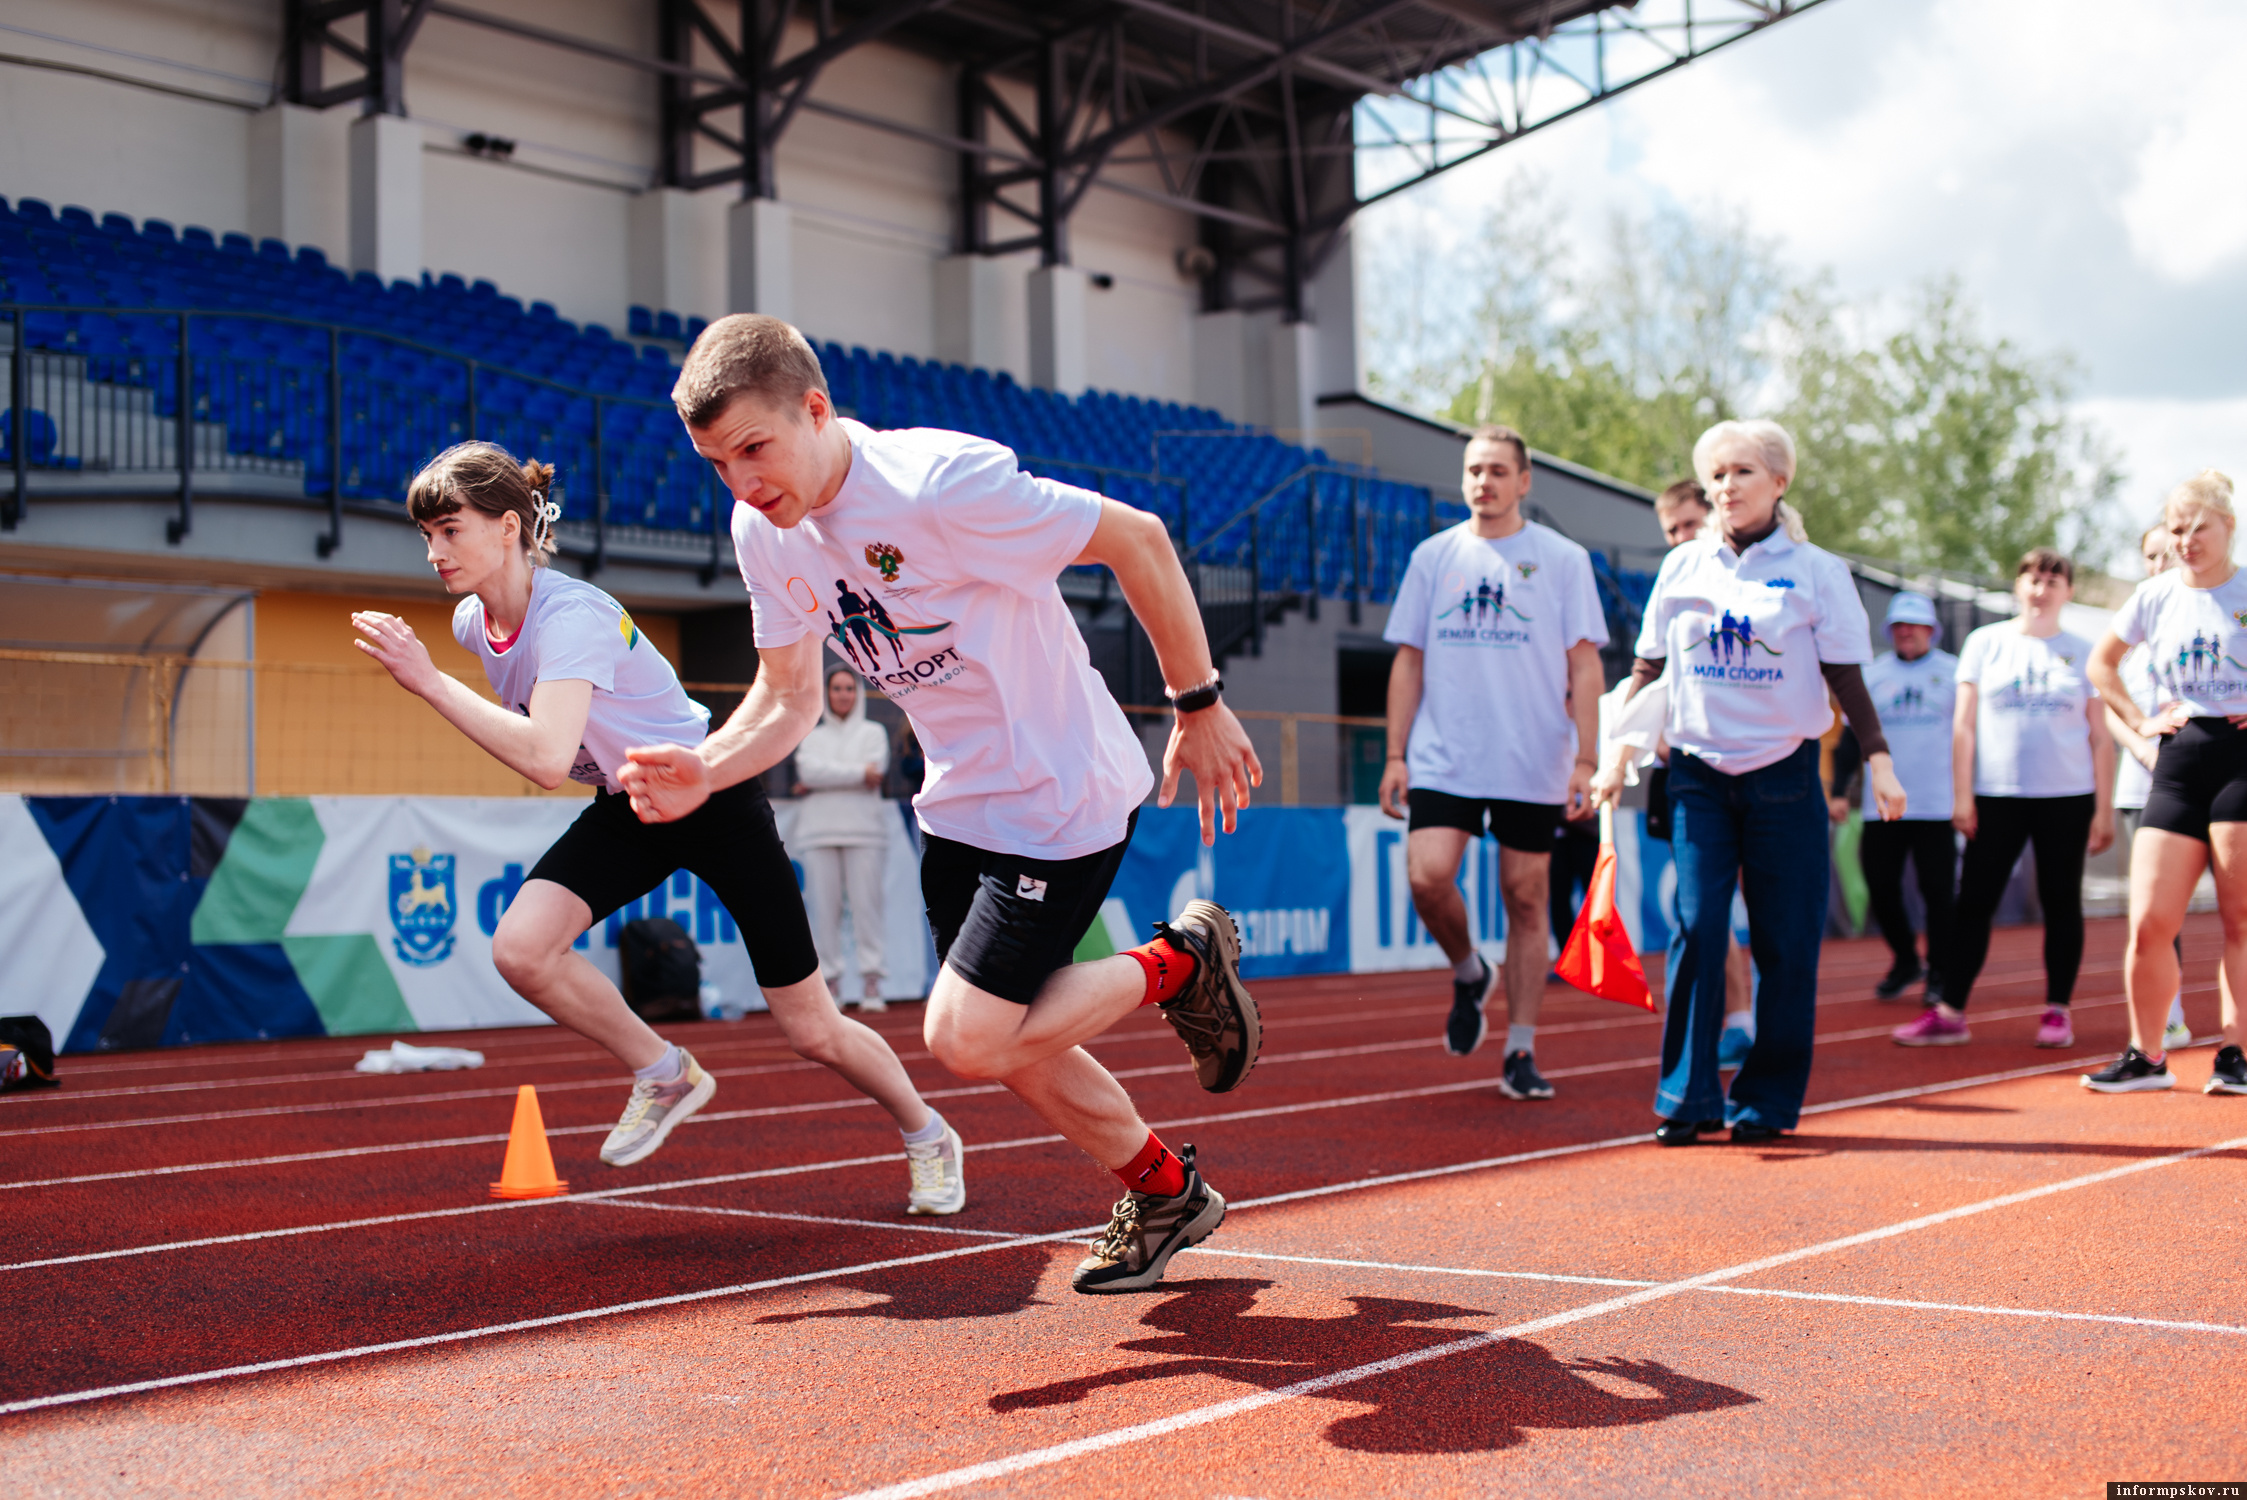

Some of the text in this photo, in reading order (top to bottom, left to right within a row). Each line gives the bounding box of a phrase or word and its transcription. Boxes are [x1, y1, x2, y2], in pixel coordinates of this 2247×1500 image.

[885, 646, 964, 684] СПОРТ
[1729, 666, 1784, 682] СПОРТА
[1138, 1148, 1168, 1183] FILA
